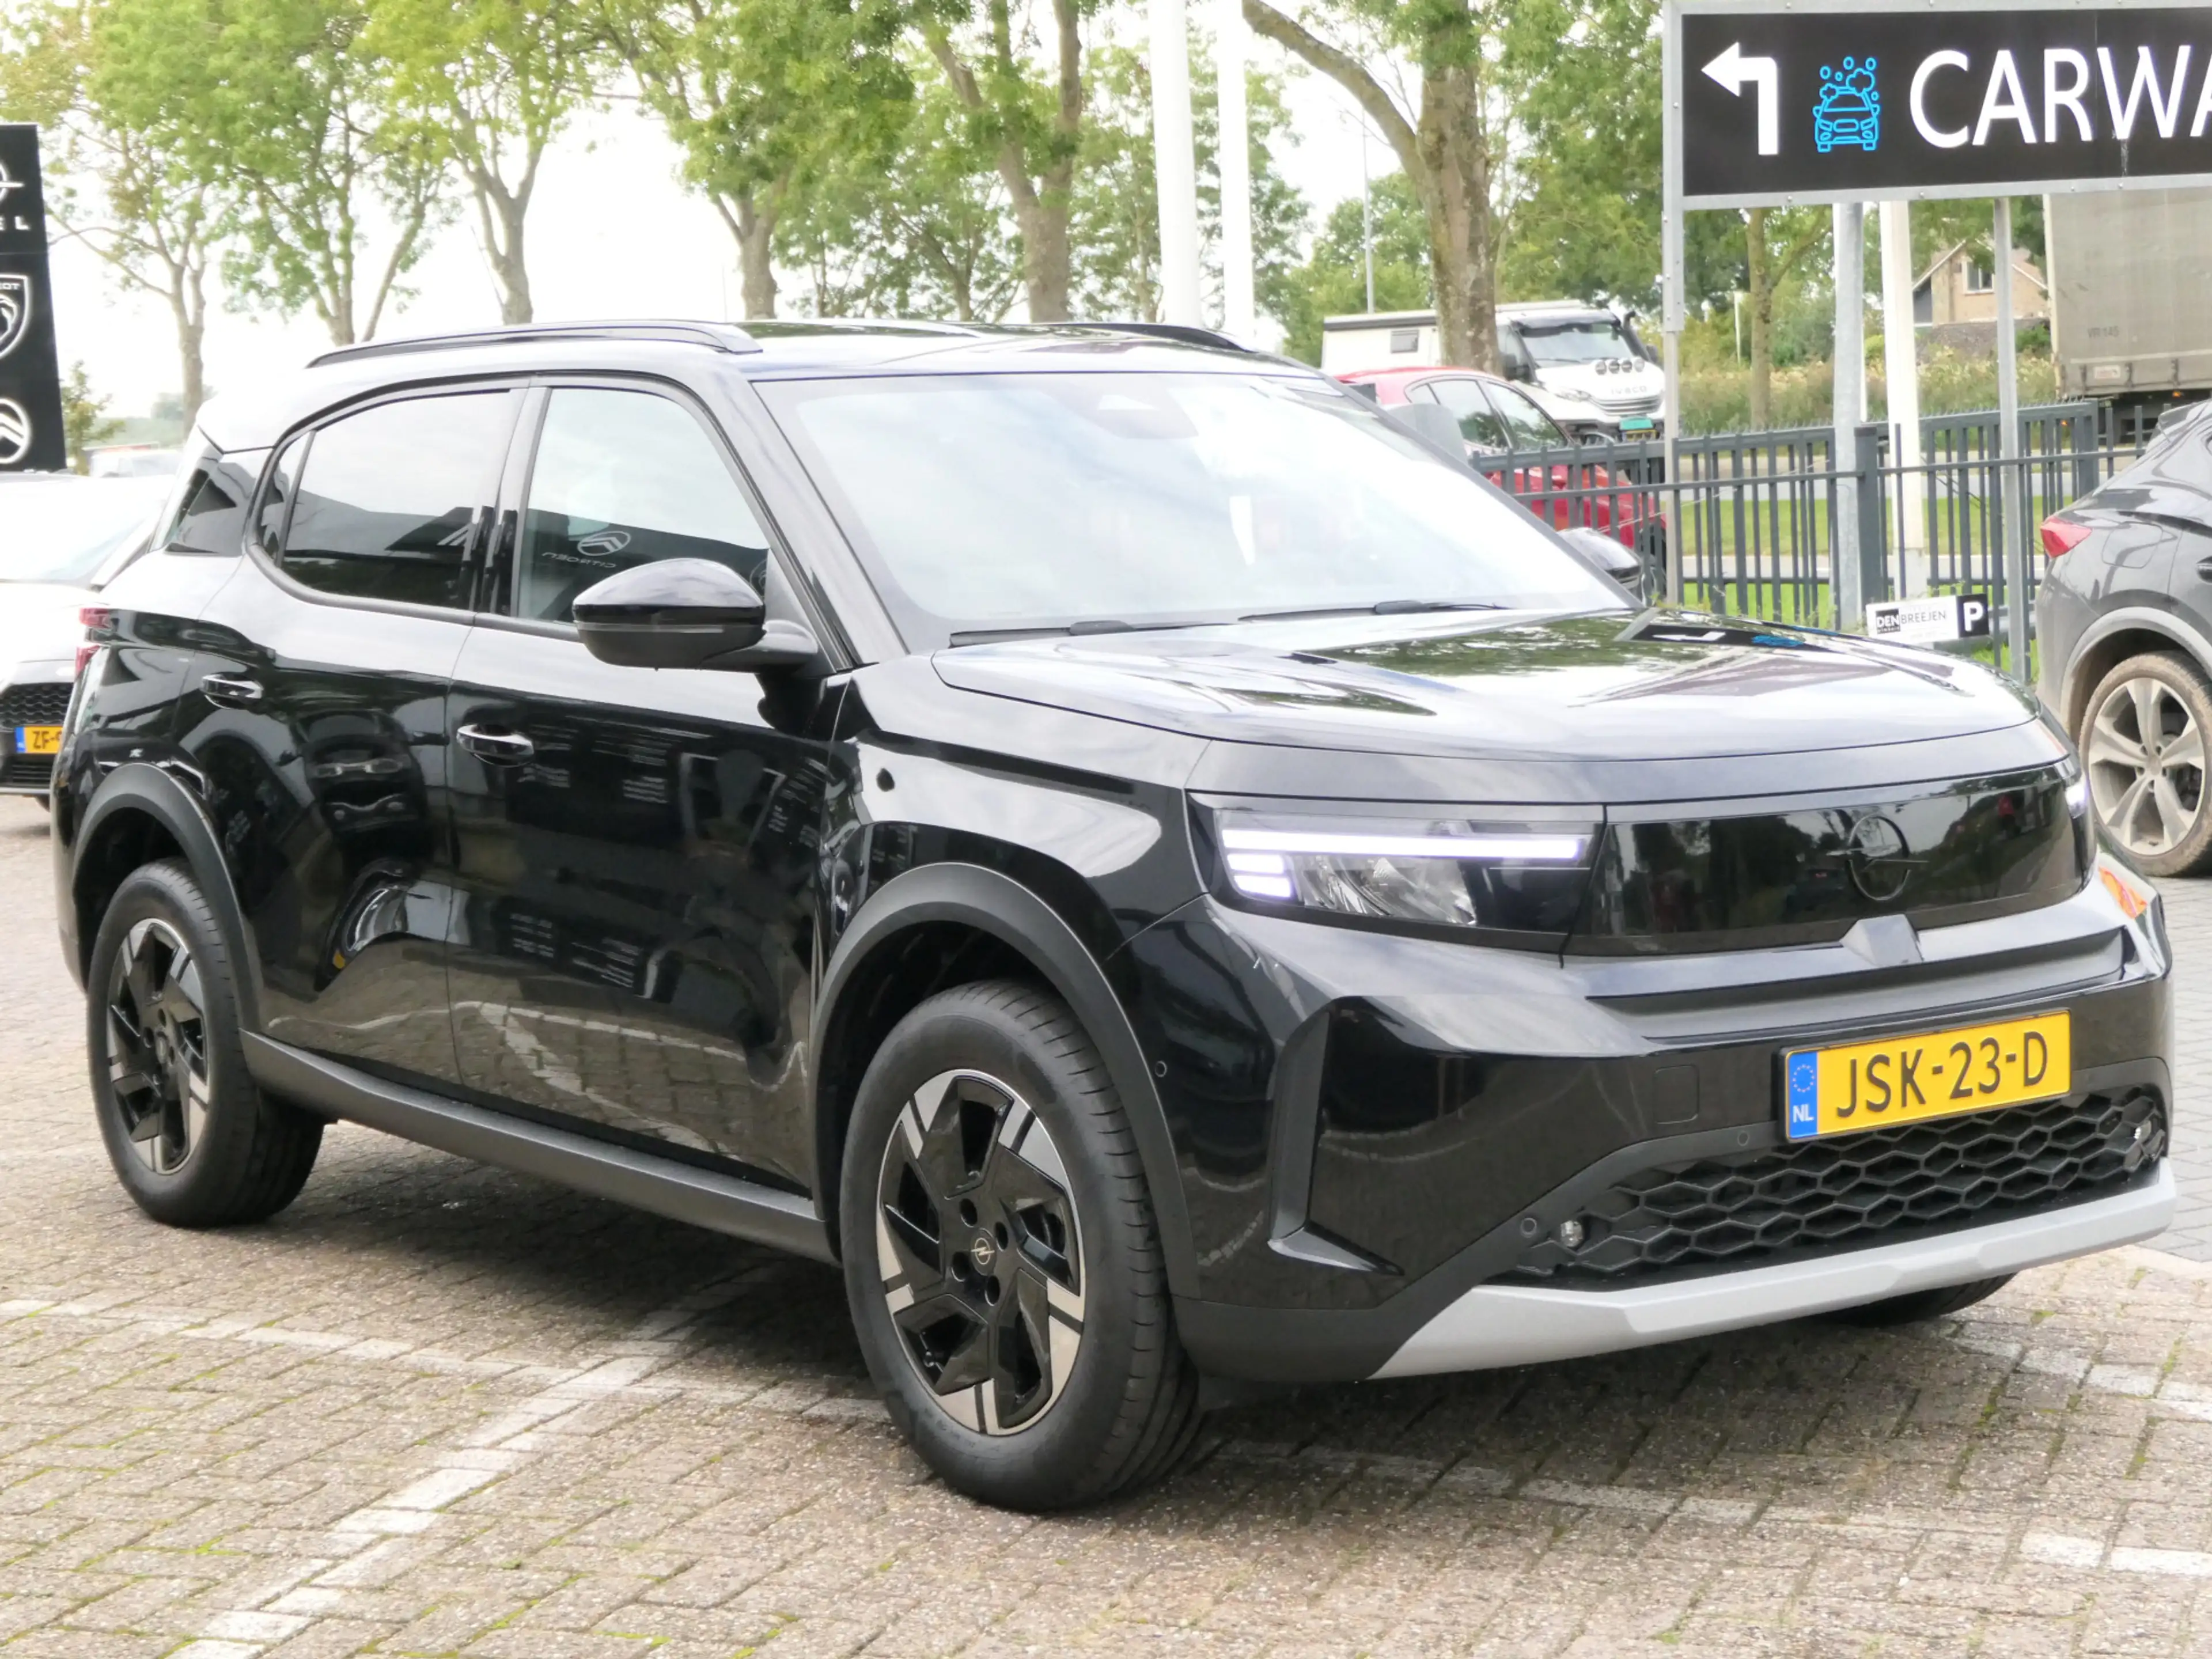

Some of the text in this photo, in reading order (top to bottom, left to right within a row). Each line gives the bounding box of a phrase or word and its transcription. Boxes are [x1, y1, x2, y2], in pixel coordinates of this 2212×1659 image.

[1877, 601, 1983, 632] DEN BREEJEN P
[1836, 1031, 2048, 1119] JSK-23-D
[1793, 1104, 1814, 1123] NL
